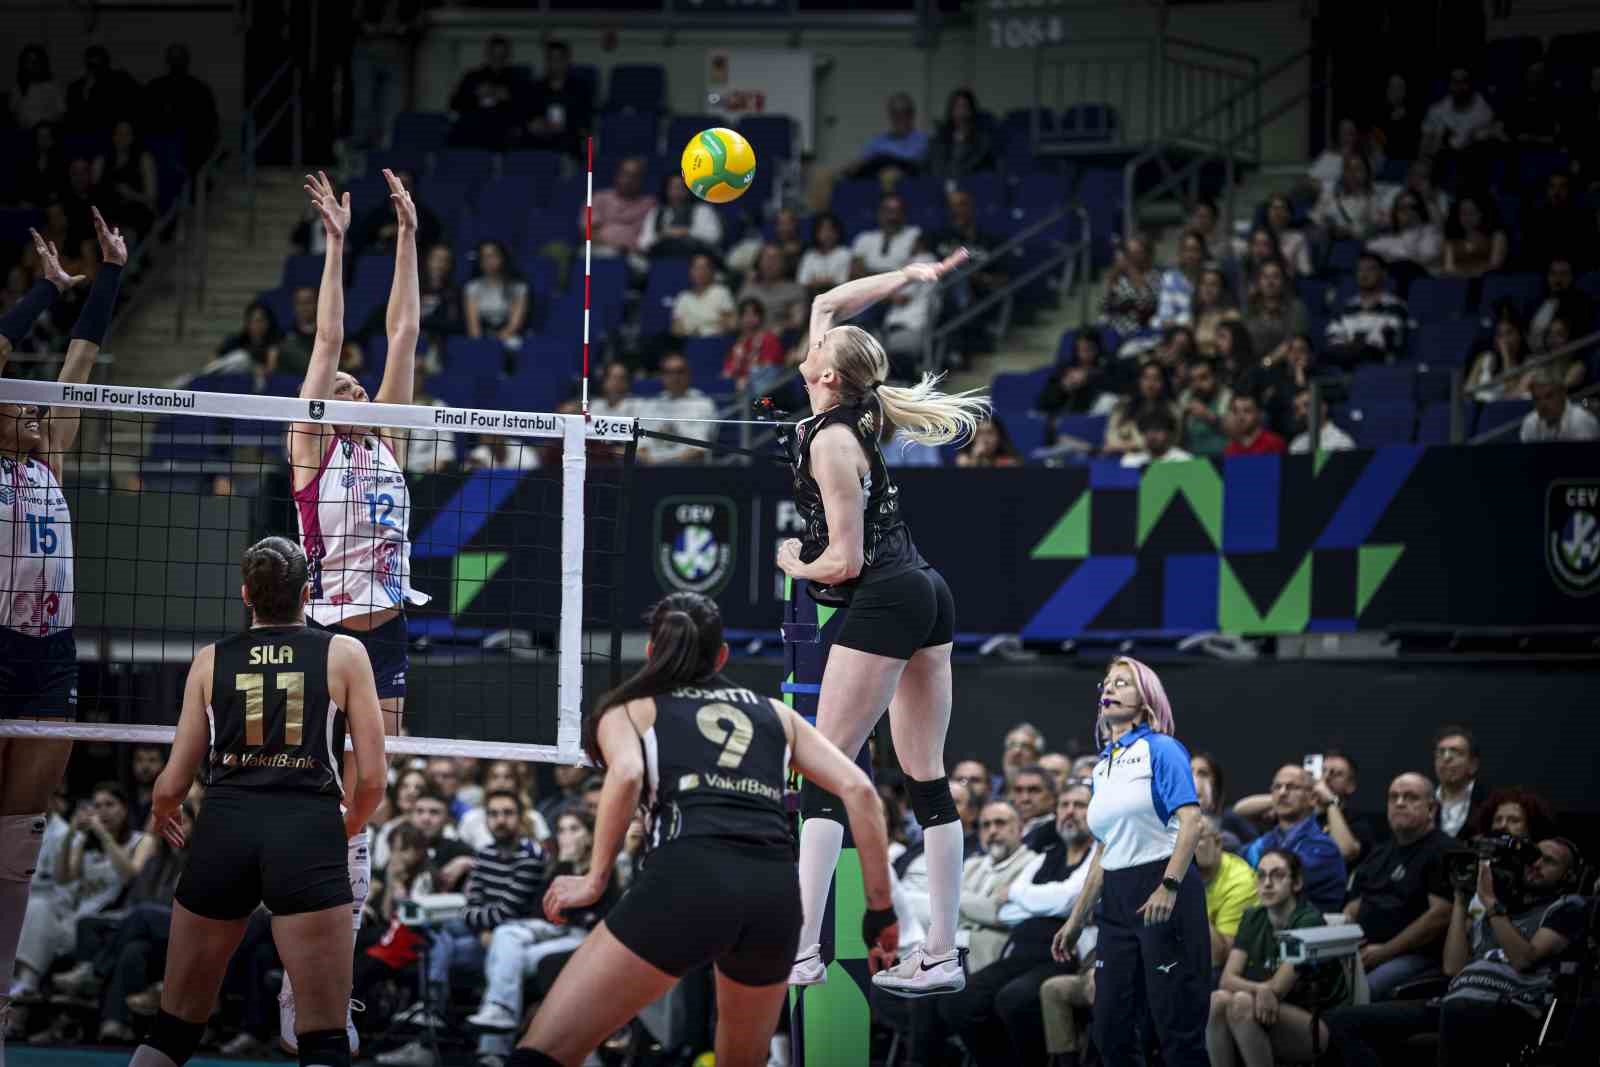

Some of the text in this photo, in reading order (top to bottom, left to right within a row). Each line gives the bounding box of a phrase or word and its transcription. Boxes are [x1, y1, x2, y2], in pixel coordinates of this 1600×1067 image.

[63, 386, 195, 408] Final Four Istanbul
[434, 409, 556, 430] Final Four Istanbul
[1566, 487, 1599, 507] CEV
[364, 493, 397, 527] 12
[675, 504, 715, 524] CEV
[26, 512, 57, 555] 15
[249, 645, 294, 665] SILA
[235, 671, 305, 746] 11
[696, 703, 754, 768] 9
